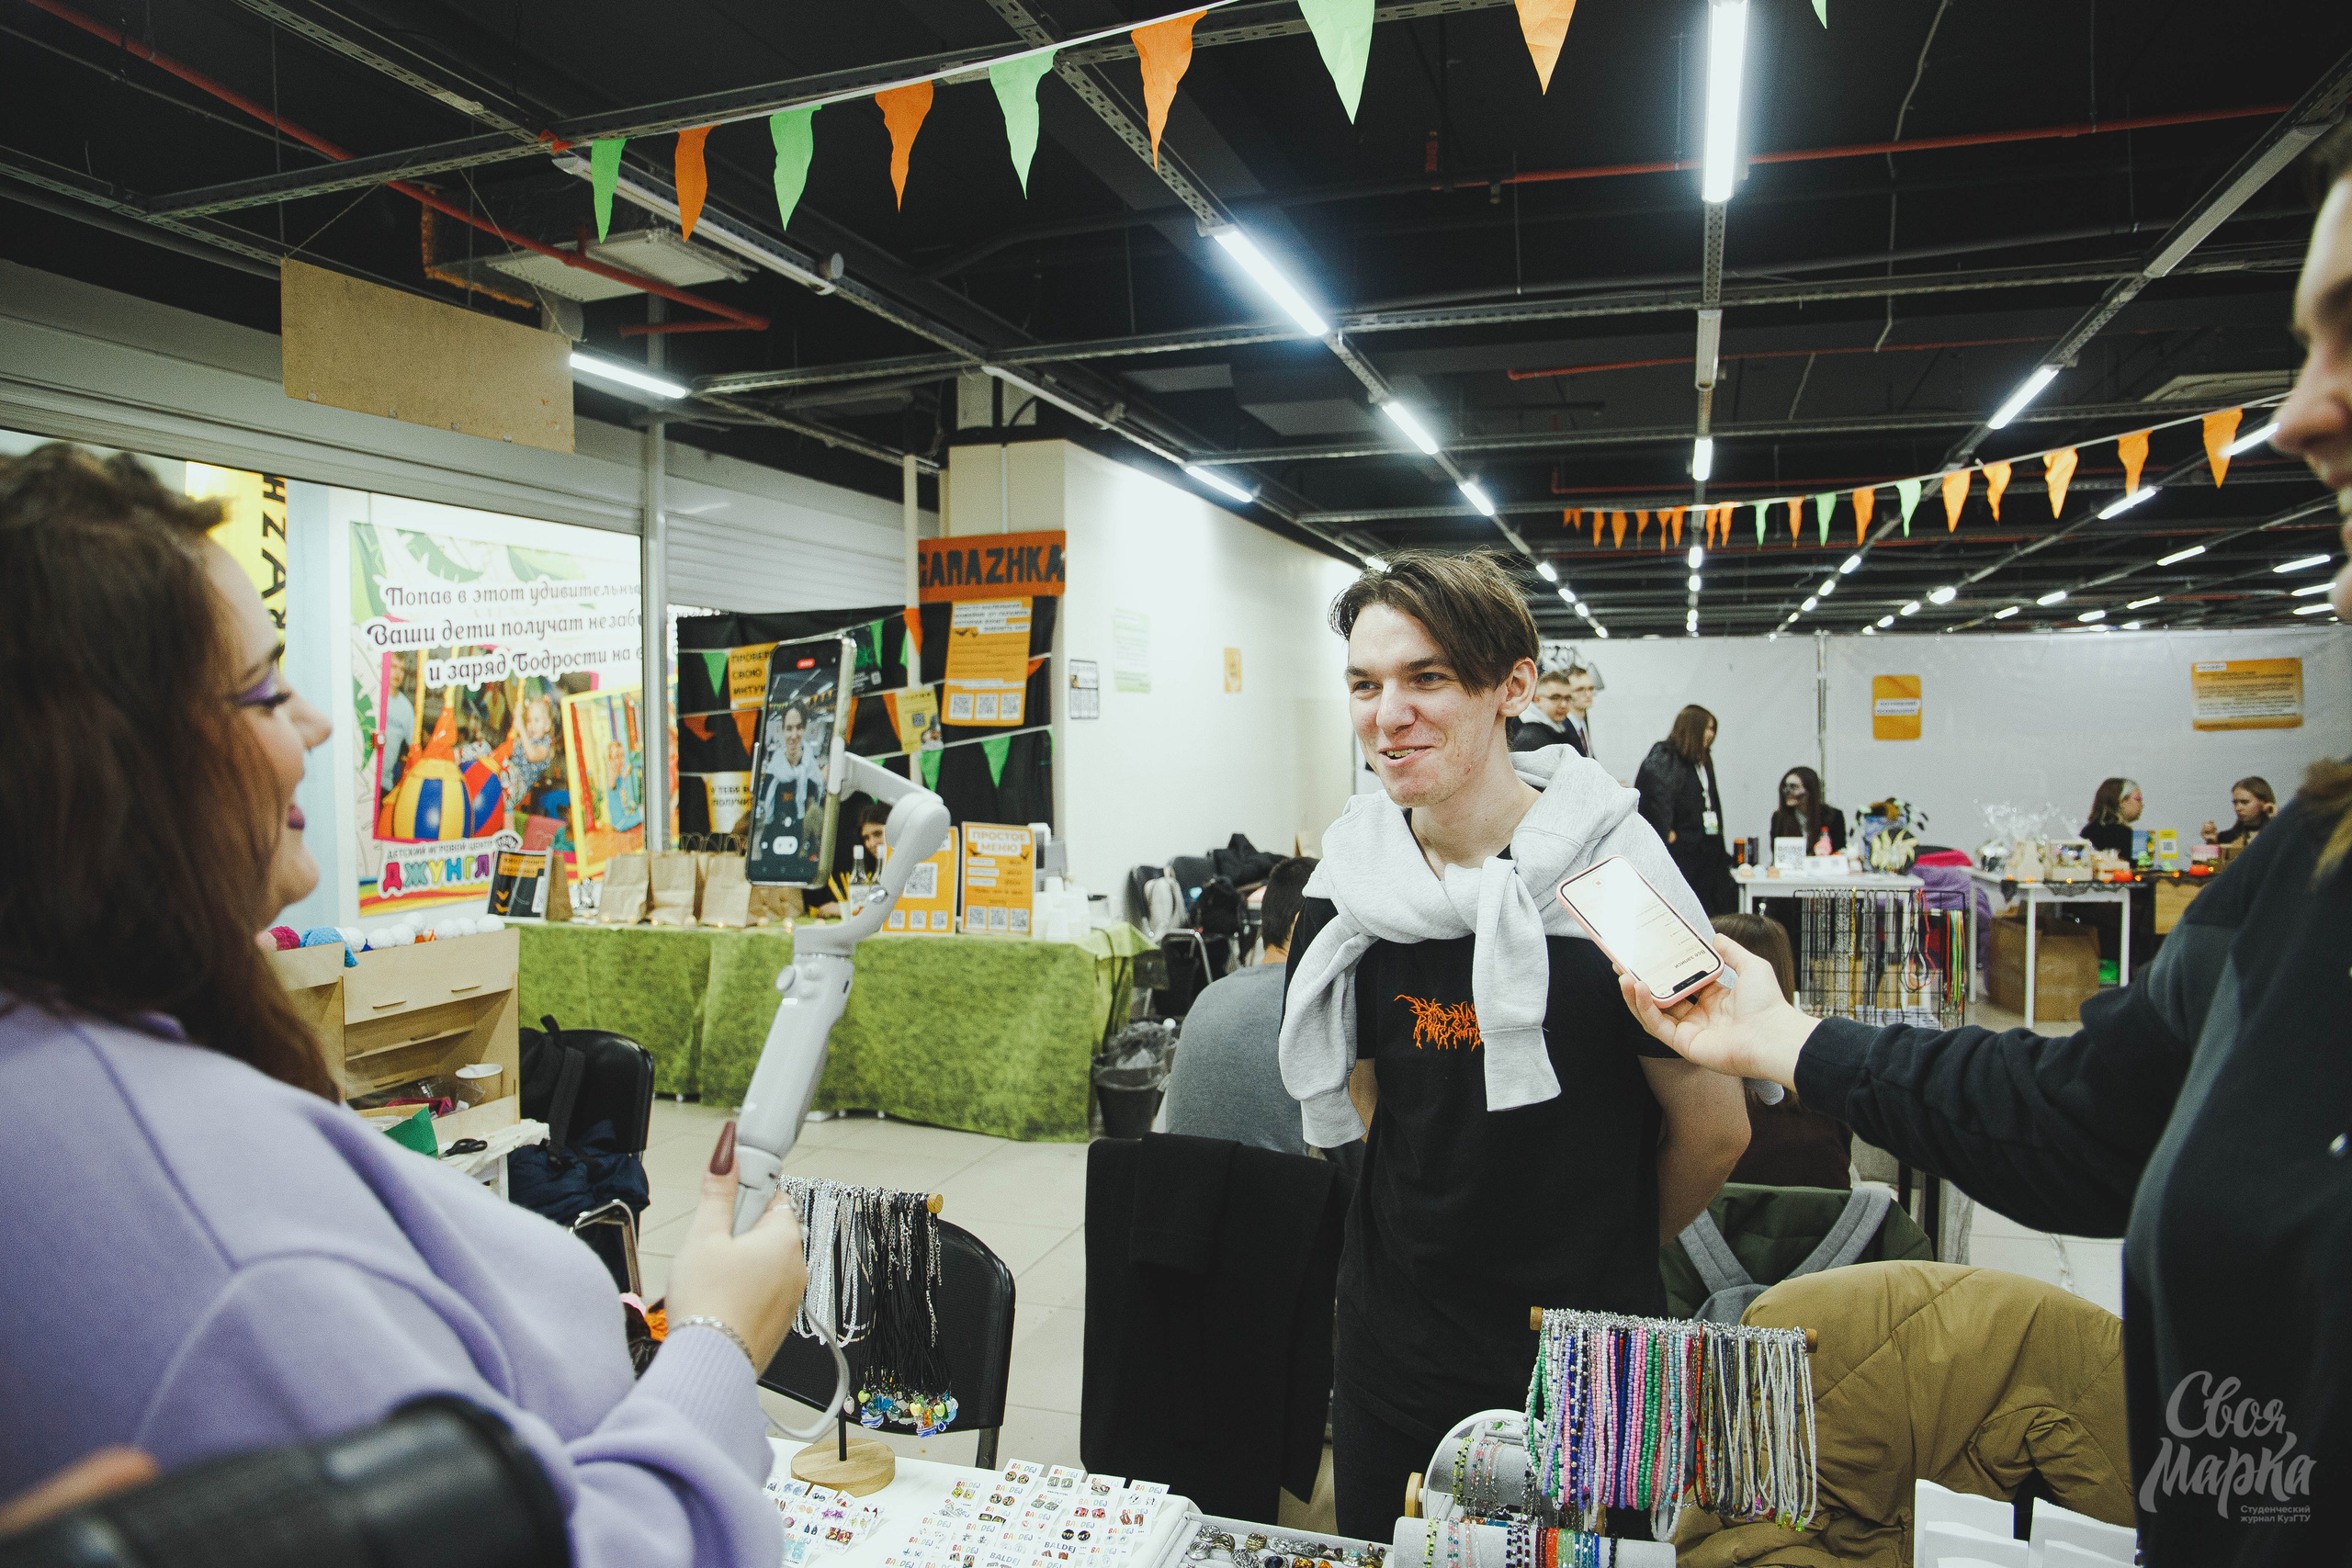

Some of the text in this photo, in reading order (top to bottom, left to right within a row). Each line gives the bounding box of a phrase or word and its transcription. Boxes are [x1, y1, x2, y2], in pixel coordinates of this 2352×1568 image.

[385, 586, 452, 606] Попав
[458, 589, 467, 604] в
[472, 586, 525, 603] этот
[368, 609, 641, 646] Ваши дети получат незаб
[428, 665, 440, 681] и
[447, 654, 506, 683] заряд
[512, 649, 606, 675] Бодрости
[613, 648, 630, 661] на
[382, 851, 496, 892] ДЖУНГЛ
[989, 1552, 1022, 1565] BALDEJ
[1044, 1541, 1077, 1553] BALDEJ
